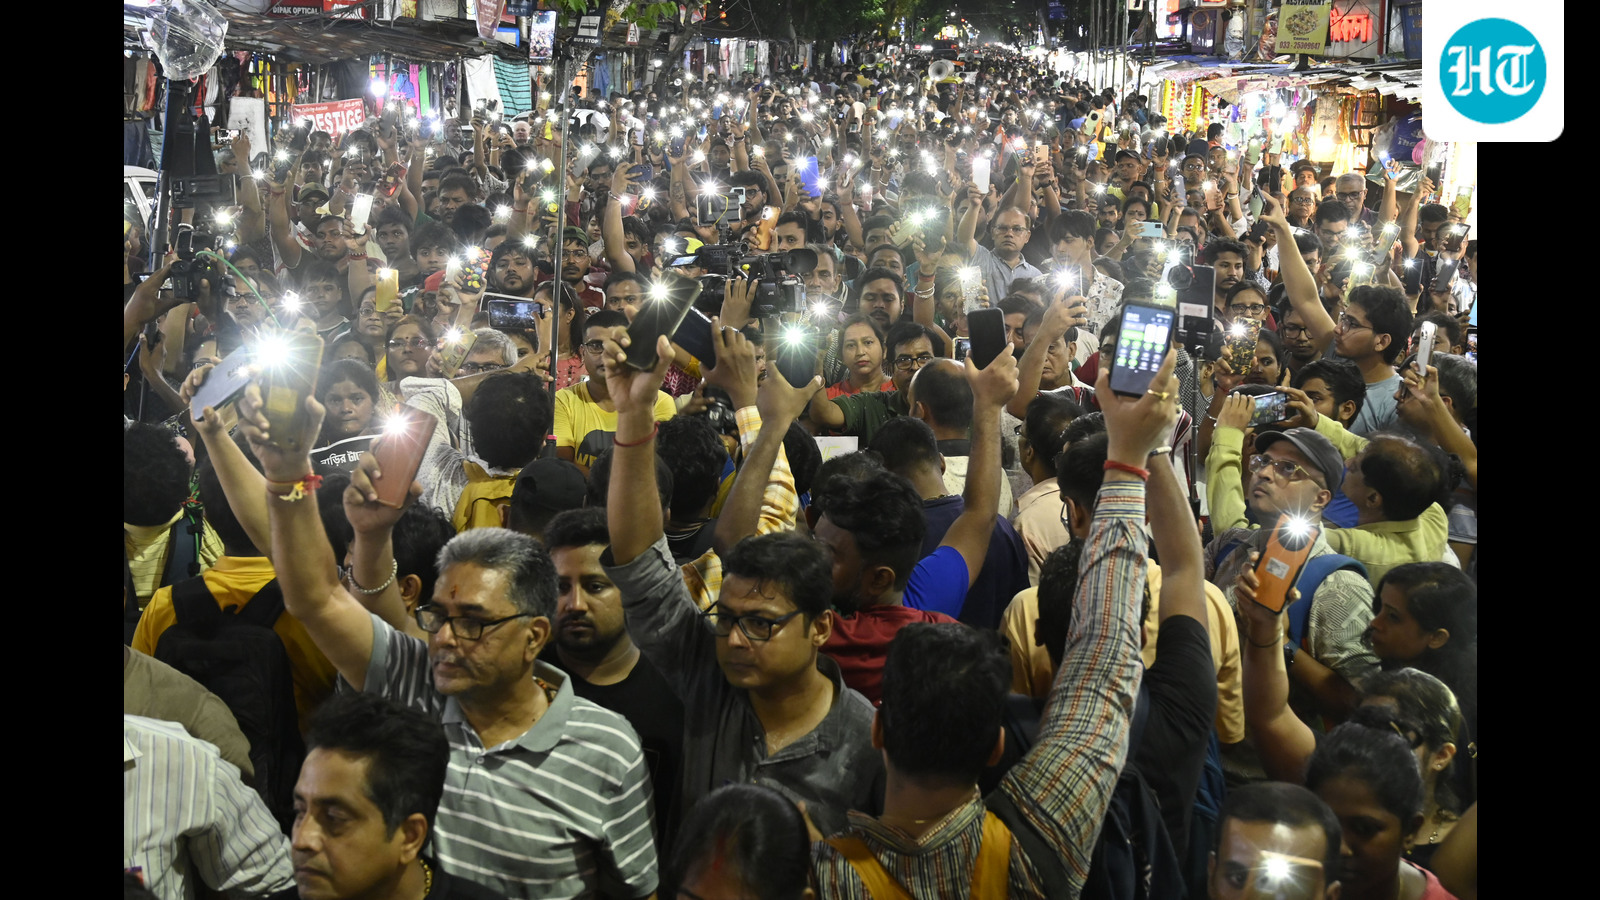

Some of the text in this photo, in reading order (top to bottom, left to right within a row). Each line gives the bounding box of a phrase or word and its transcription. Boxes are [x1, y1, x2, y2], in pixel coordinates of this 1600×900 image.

[272, 6, 319, 15] DIPAK OPTICAL
[1279, 41, 1291, 49] 033
